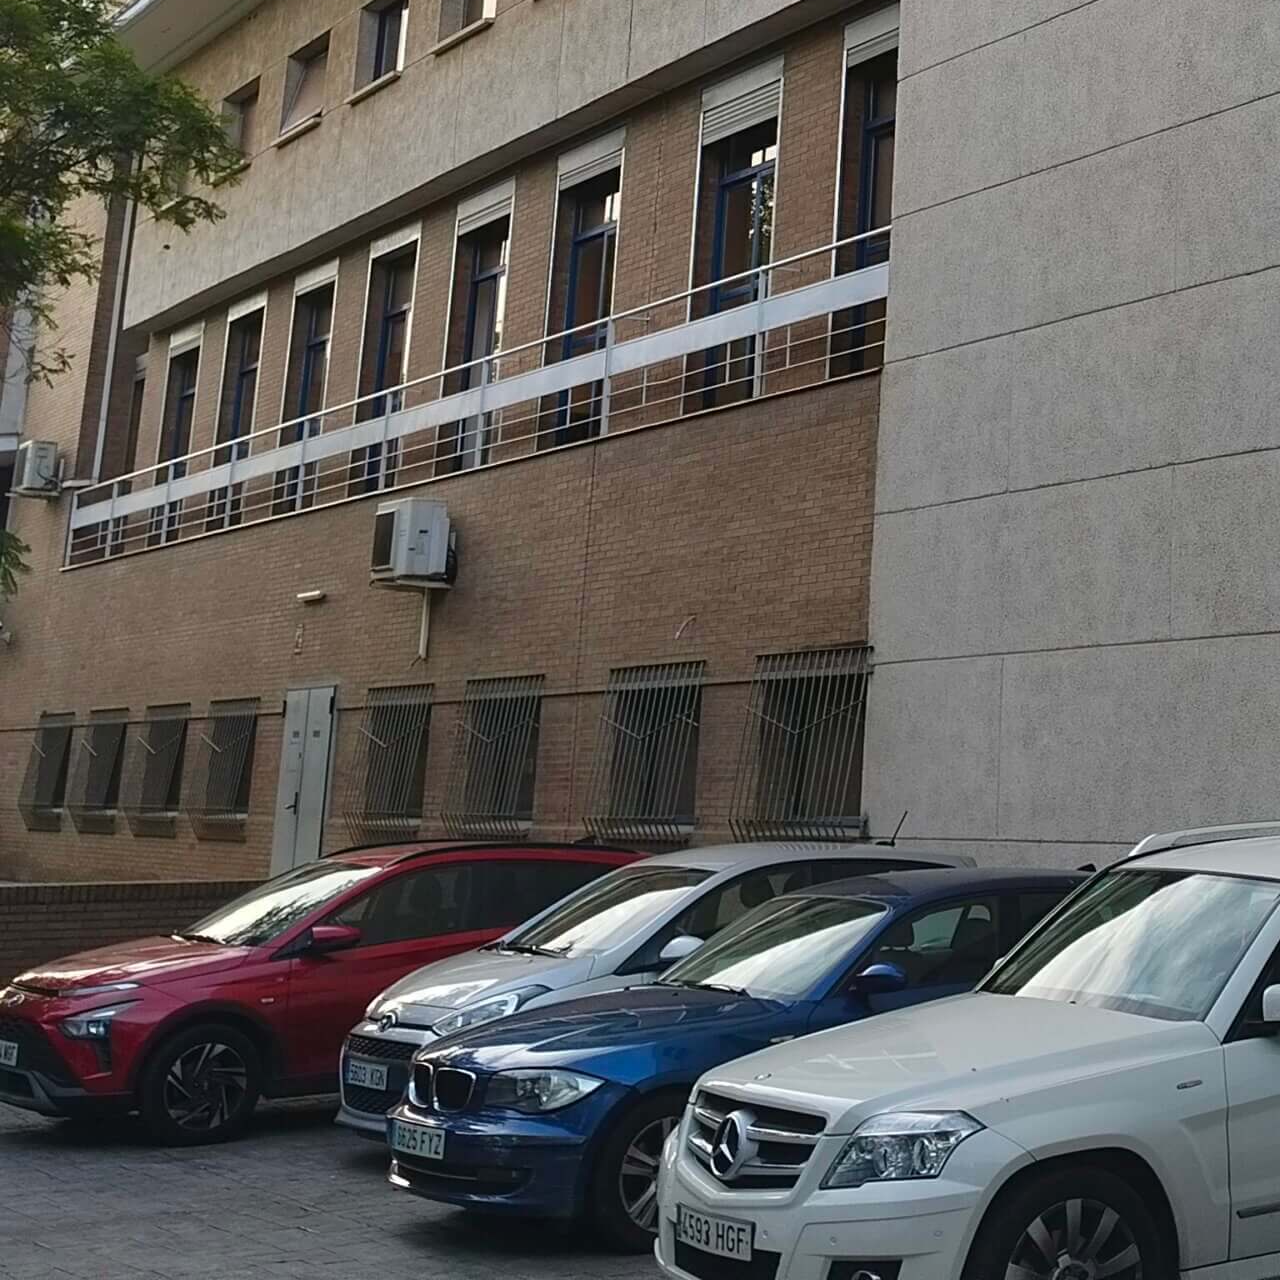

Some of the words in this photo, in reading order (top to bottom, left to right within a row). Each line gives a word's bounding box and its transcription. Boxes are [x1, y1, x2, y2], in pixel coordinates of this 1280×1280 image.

[420, 1131, 442, 1156] FYZ
[682, 1212, 711, 1246] 4593
[715, 1221, 746, 1254] HGF
